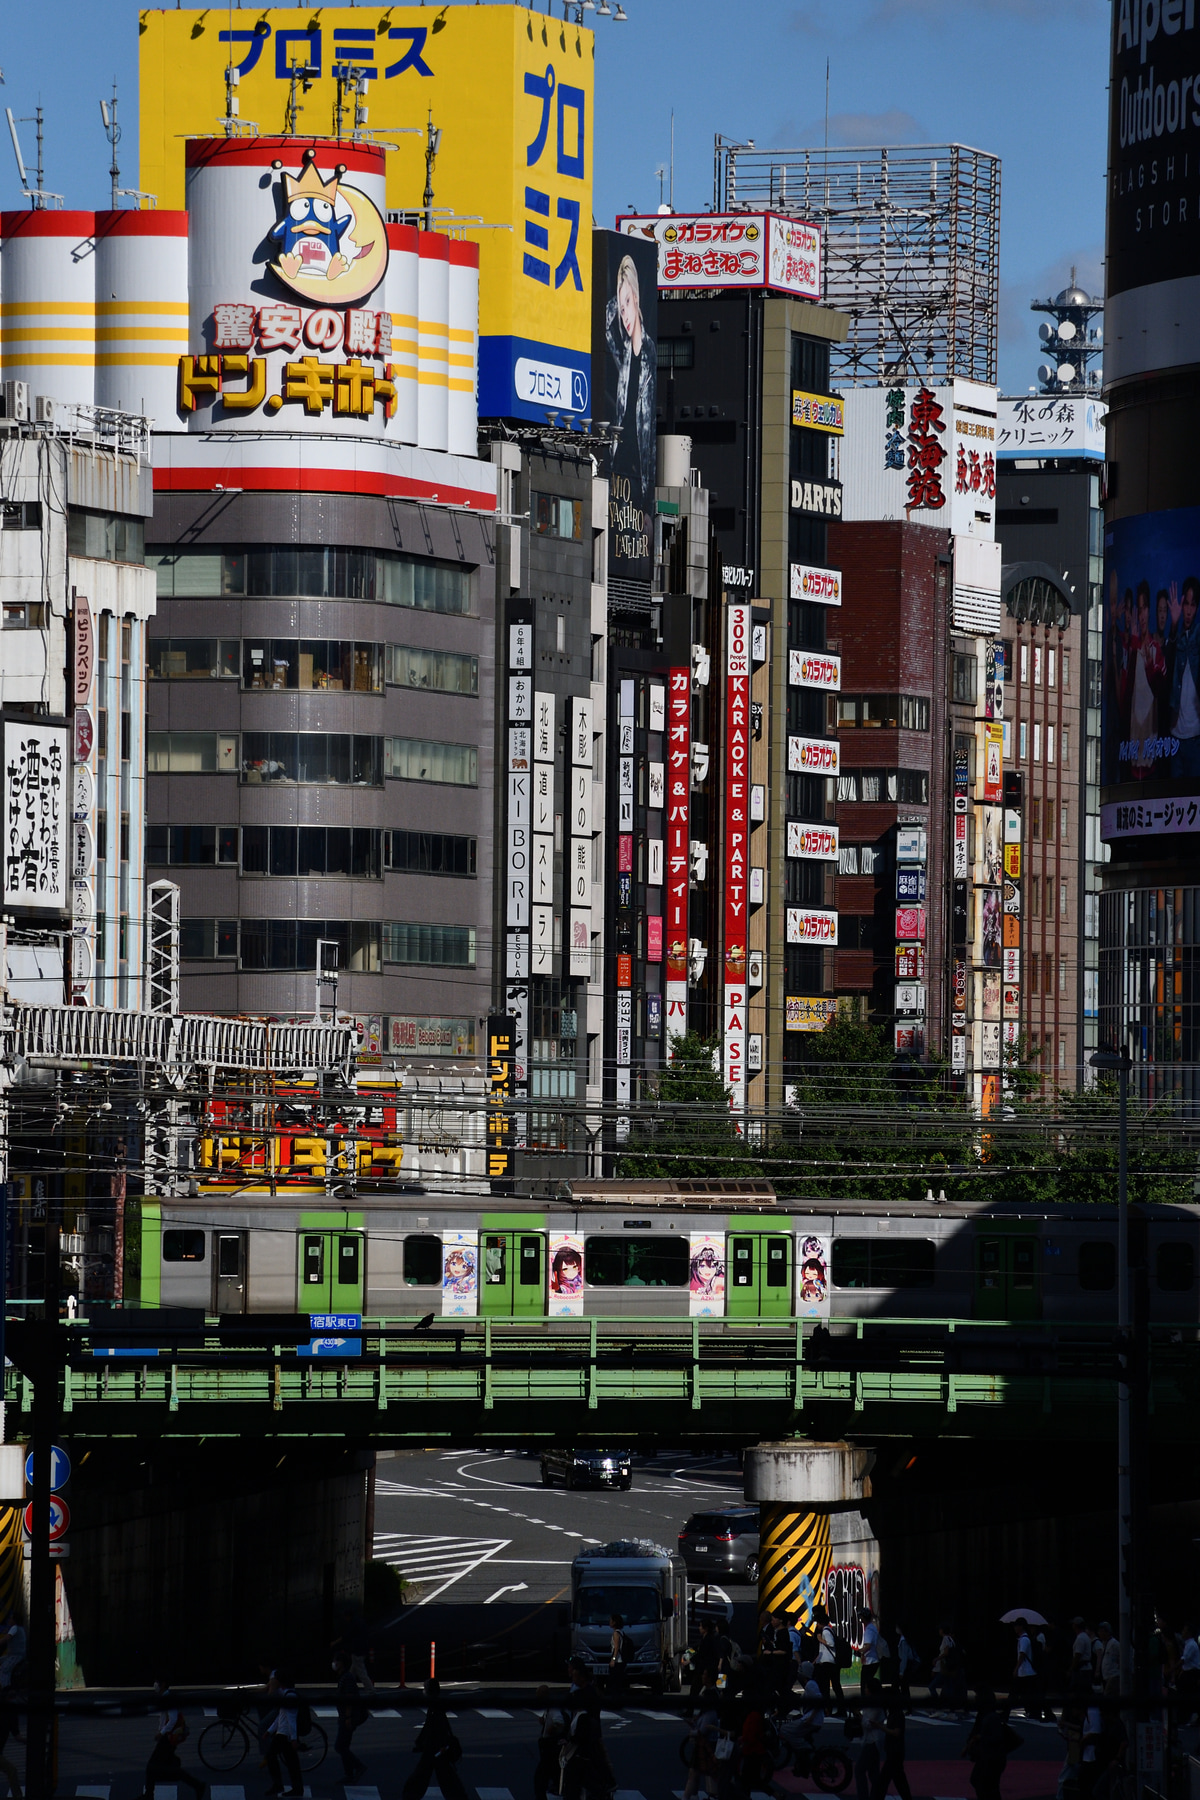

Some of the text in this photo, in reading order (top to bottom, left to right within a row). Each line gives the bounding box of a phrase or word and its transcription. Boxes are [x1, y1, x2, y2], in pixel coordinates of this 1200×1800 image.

[219, 22, 434, 79] プロミス
[1112, 153, 1200, 198] FLAGSHI
[1135, 198, 1200, 232] STOR
[677, 223, 744, 243] カラオケ
[789, 229, 816, 250] カラオケ
[664, 249, 760, 281] まねきねこ
[785, 254, 817, 288] まねきねこ
[212, 304, 393, 357] 驚安の殿堂
[529, 371, 562, 400] プロミス
[1016, 404, 1075, 424] 水の森
[903, 387, 946, 511] 東海苑
[997, 427, 1075, 447] クリニック
[611, 472, 631, 502] MIO
[955, 442, 996, 500] 東海苑
[791, 479, 842, 516] DARTS
[608, 500, 644, 533] YASHIRO
[807, 571, 834, 598] カラオケ
[516, 628, 525, 666] 6年4組
[732, 609, 744, 653] 300
[730, 661, 746, 671] OK
[806, 658, 833, 684] カラオケ
[515, 681, 525, 716] おかか
[518, 731, 526, 757] 北海道
[731, 677, 745, 797] KARAOKE
[806, 744, 833, 770] カラオケ
[7, 759, 21, 892] だけの店
[731, 808, 744, 821] &
[512, 778, 526, 920] KIBORI
[804, 831, 832, 854] カラオケ
[730, 833, 744, 917] PARTY
[899, 875, 917, 885] 麻雀
[804, 916, 831, 938] カラオケ
[310, 1316, 357, 1328] 宿駅東口
